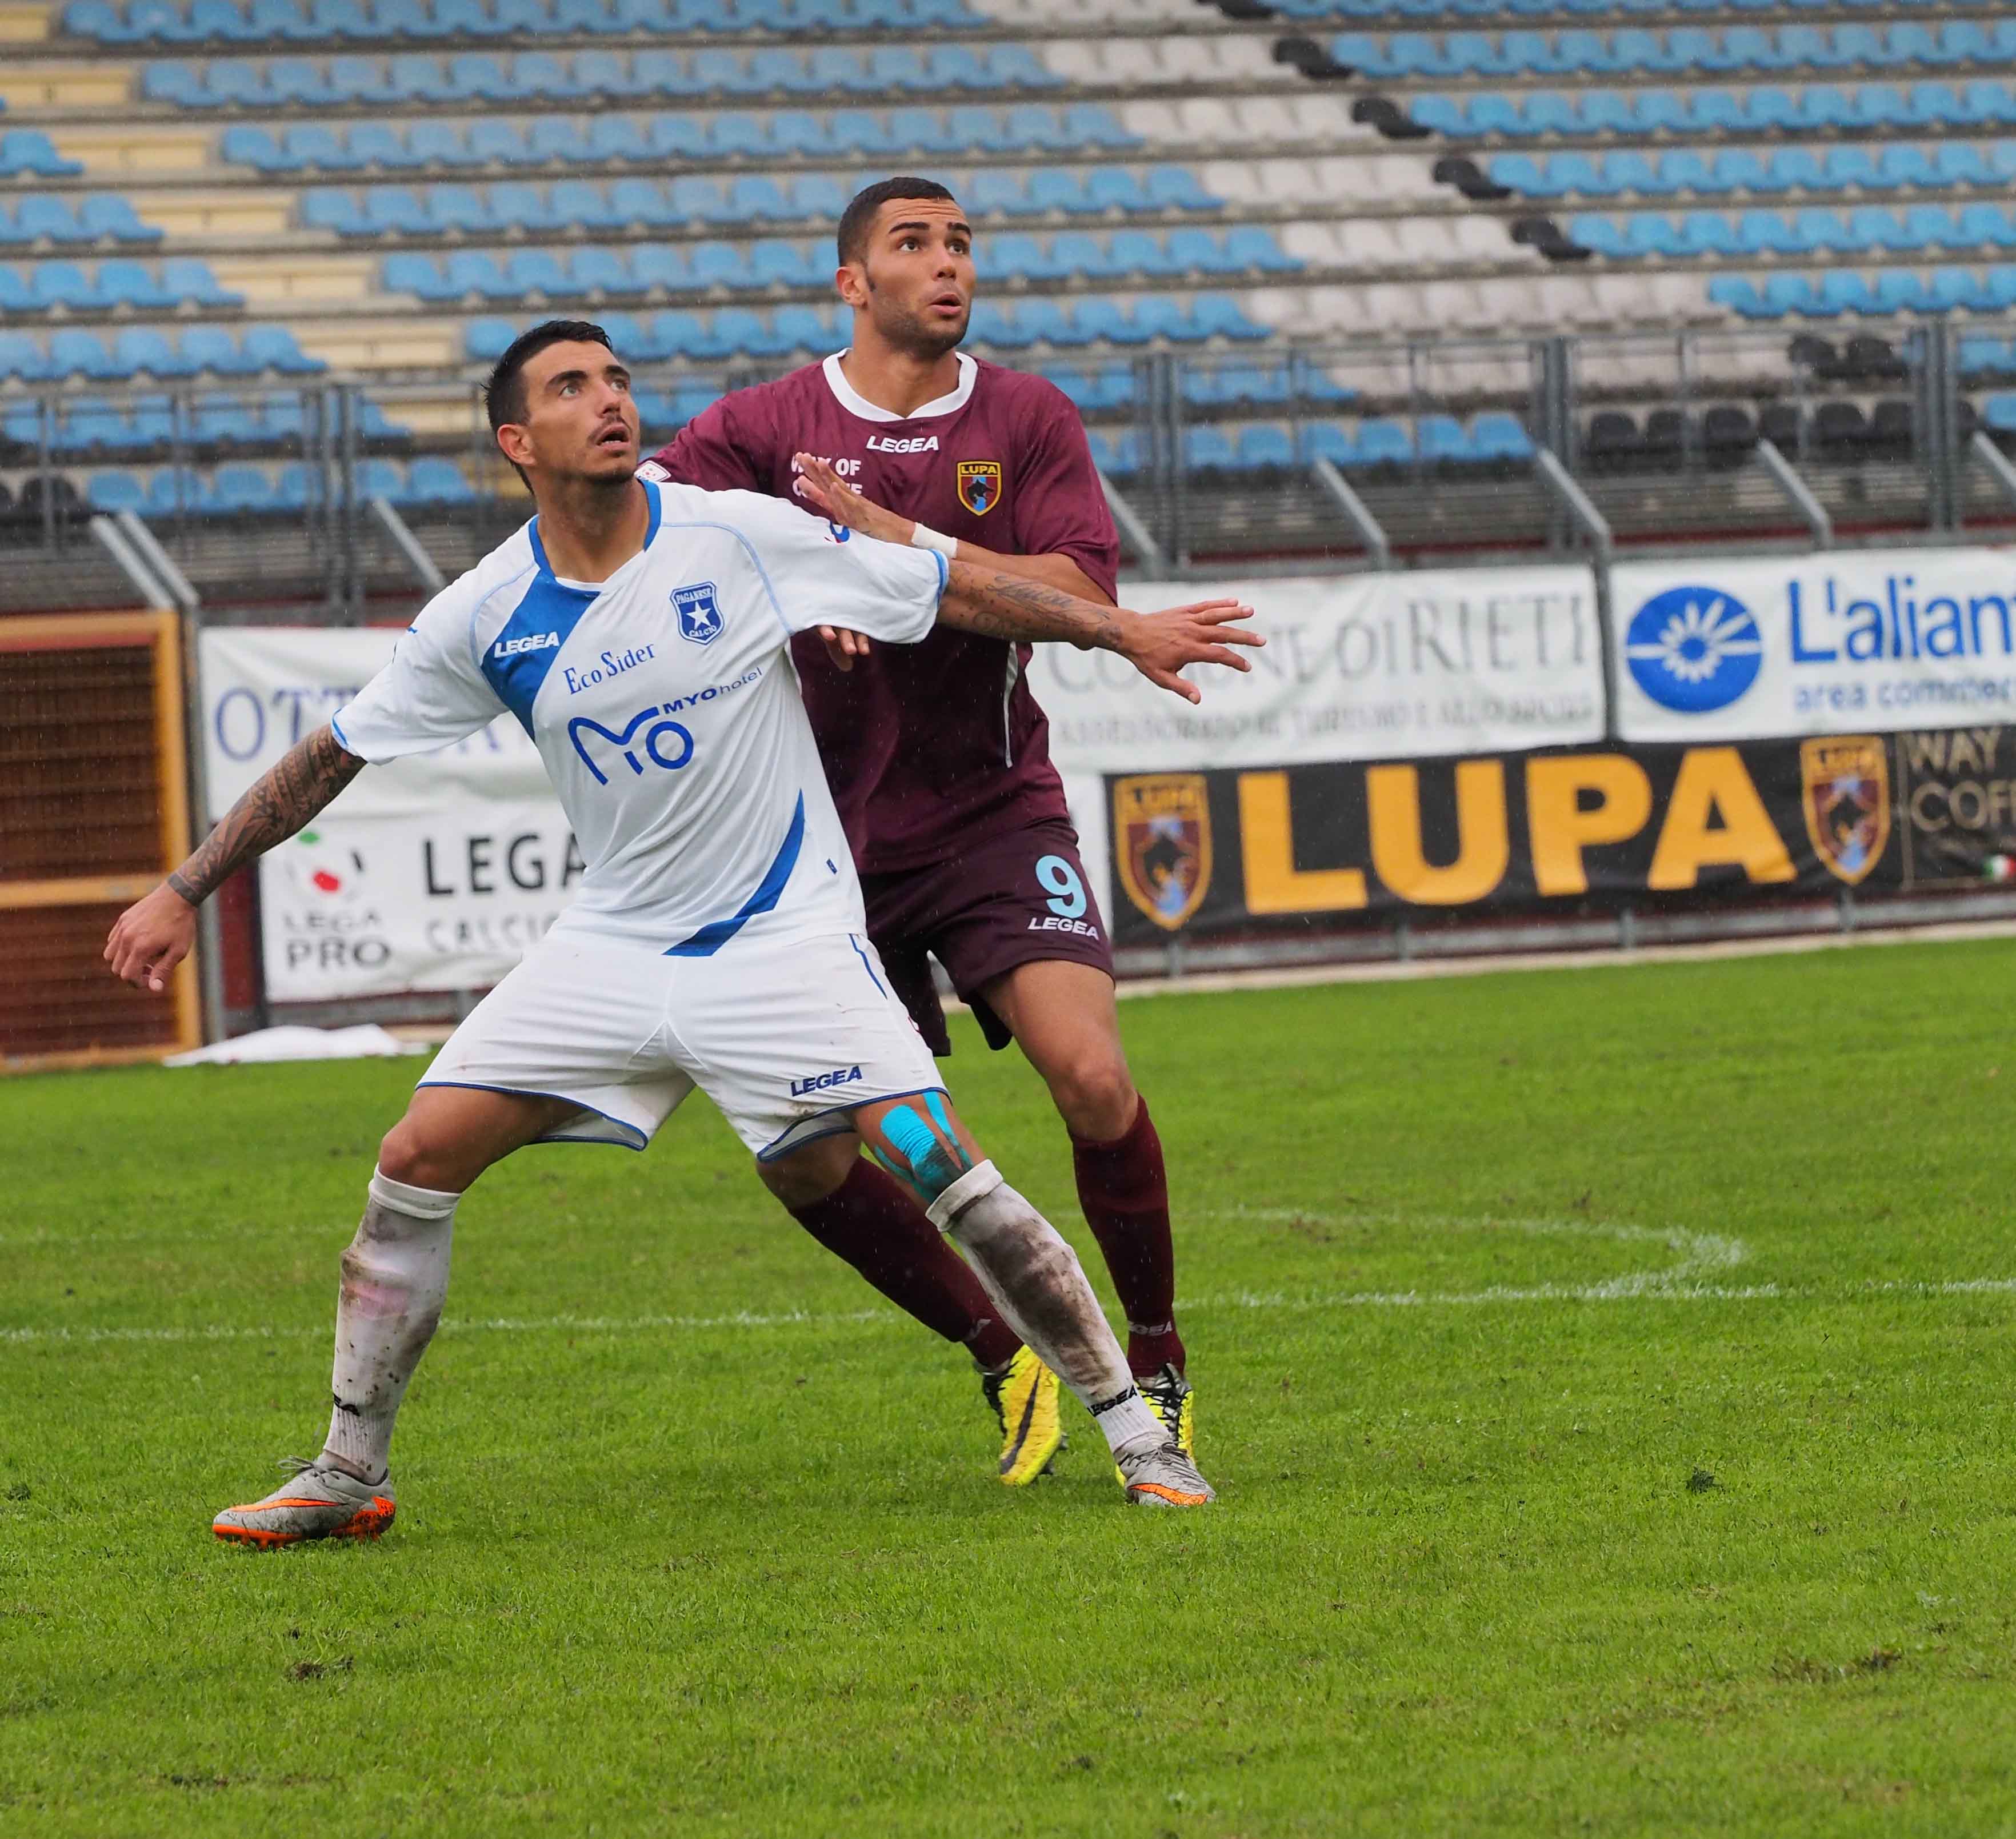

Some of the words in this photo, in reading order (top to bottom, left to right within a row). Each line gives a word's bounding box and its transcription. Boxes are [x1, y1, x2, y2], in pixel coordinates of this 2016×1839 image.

[835, 459, 861, 476] OF
[866, 435, 939, 453] LEGEA
[961, 465, 997, 474] LUPA
[1408, 593, 1585, 673] RIETI
[1789, 576, 2016, 663] L'alian
[494, 631, 559, 658] LEGEA
[563, 667, 602, 695] Eco
[601, 644, 655, 677] Sider
[1906, 728, 2001, 775] WAY
[1910, 778, 2016, 832] COF
[1237, 747, 1798, 914] LUPA
[425, 831, 587, 895] LEGA
[1035, 855, 1087, 919] 9
[287, 936, 391, 969] PRO
[1027, 917, 1099, 941] LEGEA
[790, 1065, 862, 1097] LEGEA
